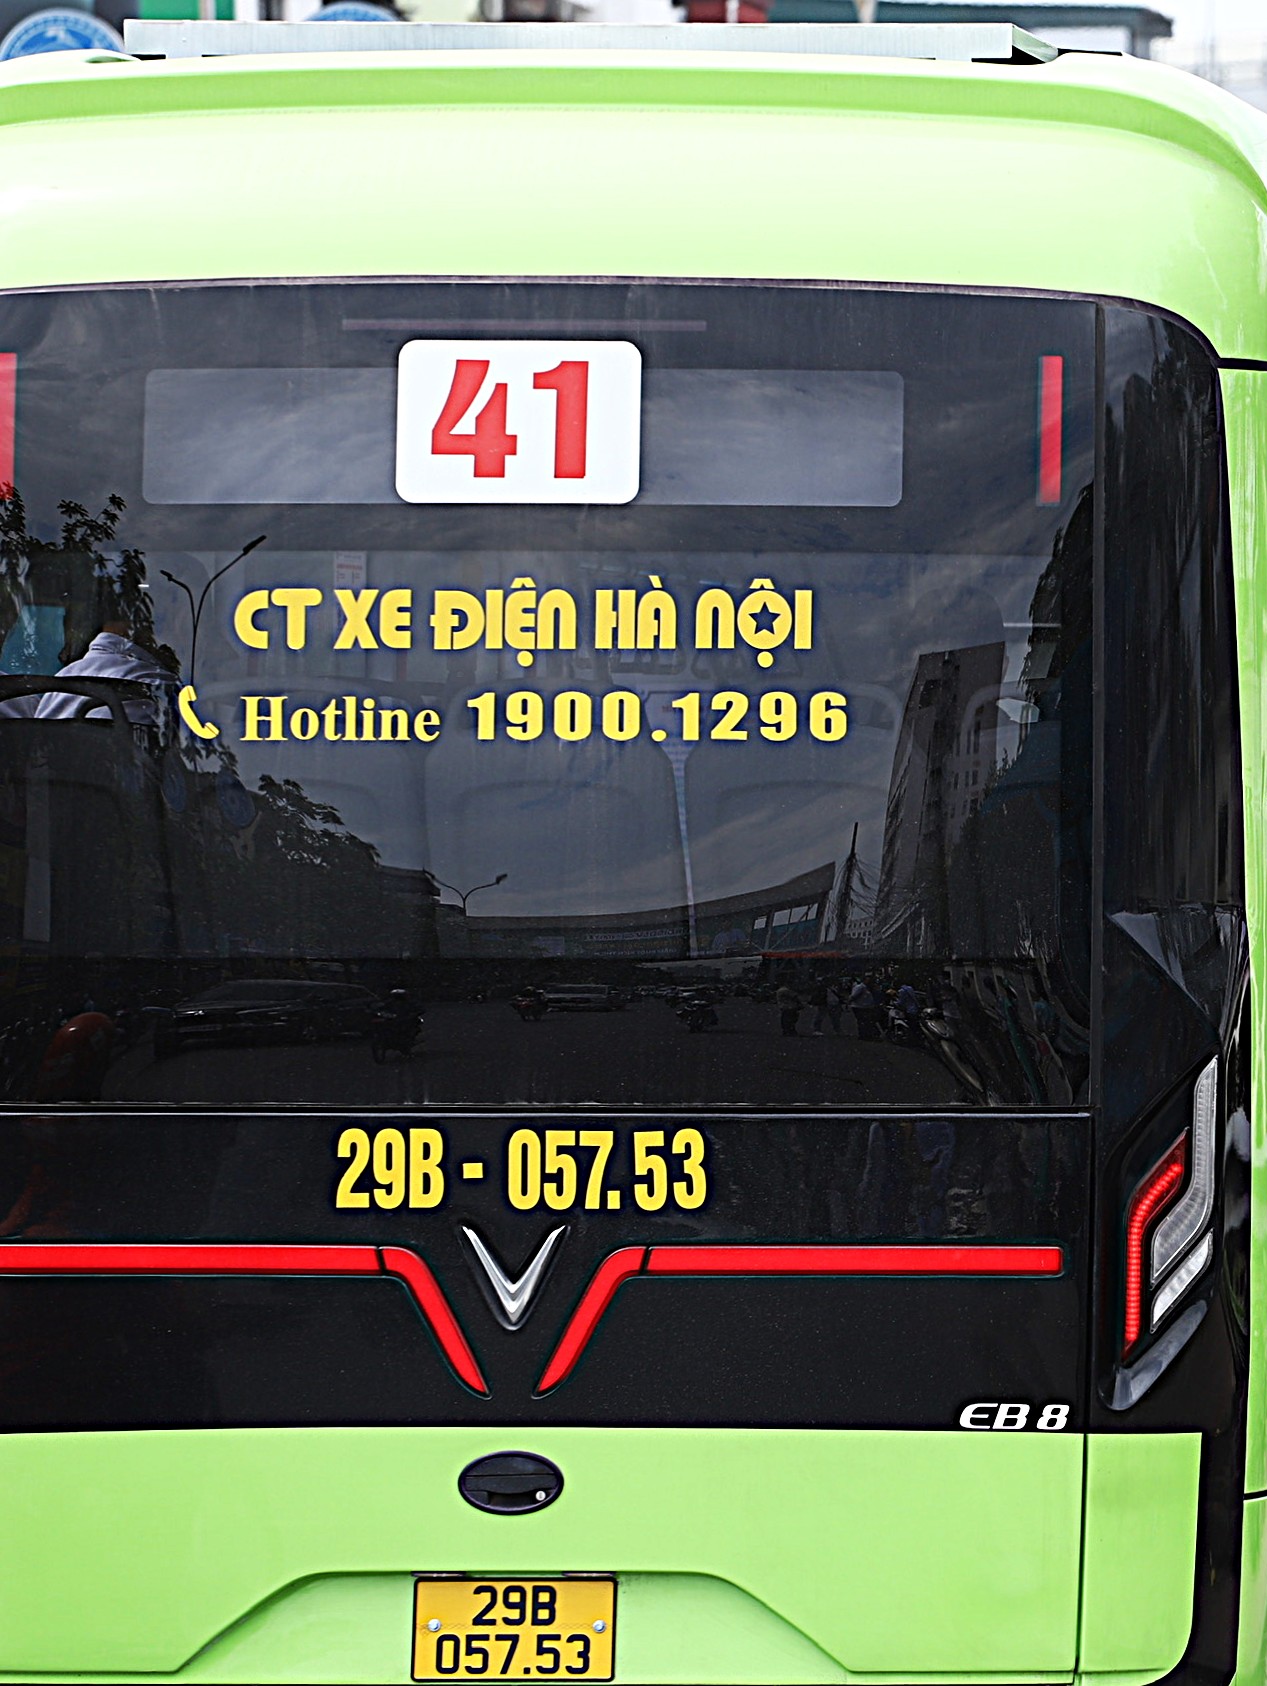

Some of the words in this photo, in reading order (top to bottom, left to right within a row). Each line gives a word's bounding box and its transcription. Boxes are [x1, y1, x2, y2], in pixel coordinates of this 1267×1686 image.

[430, 359, 590, 479] 41
[234, 586, 322, 651] CT
[333, 588, 412, 651] XE
[430, 577, 577, 667] ĐIỆN
[595, 575, 678, 651] HÀ
[695, 577, 813, 668] NỘI
[239, 695, 441, 743] Hotline
[467, 691, 849, 743] 1900.1296
[335, 1127, 445, 1209] 29B
[462, 1162, 485, 1180] -
[508, 1127, 707, 1211] 057.53
[959, 1402, 1031, 1430] EB
[1036, 1404, 1070, 1430] 8
[471, 1584, 557, 1628] 29B
[434, 1632, 592, 1676] 057.53
